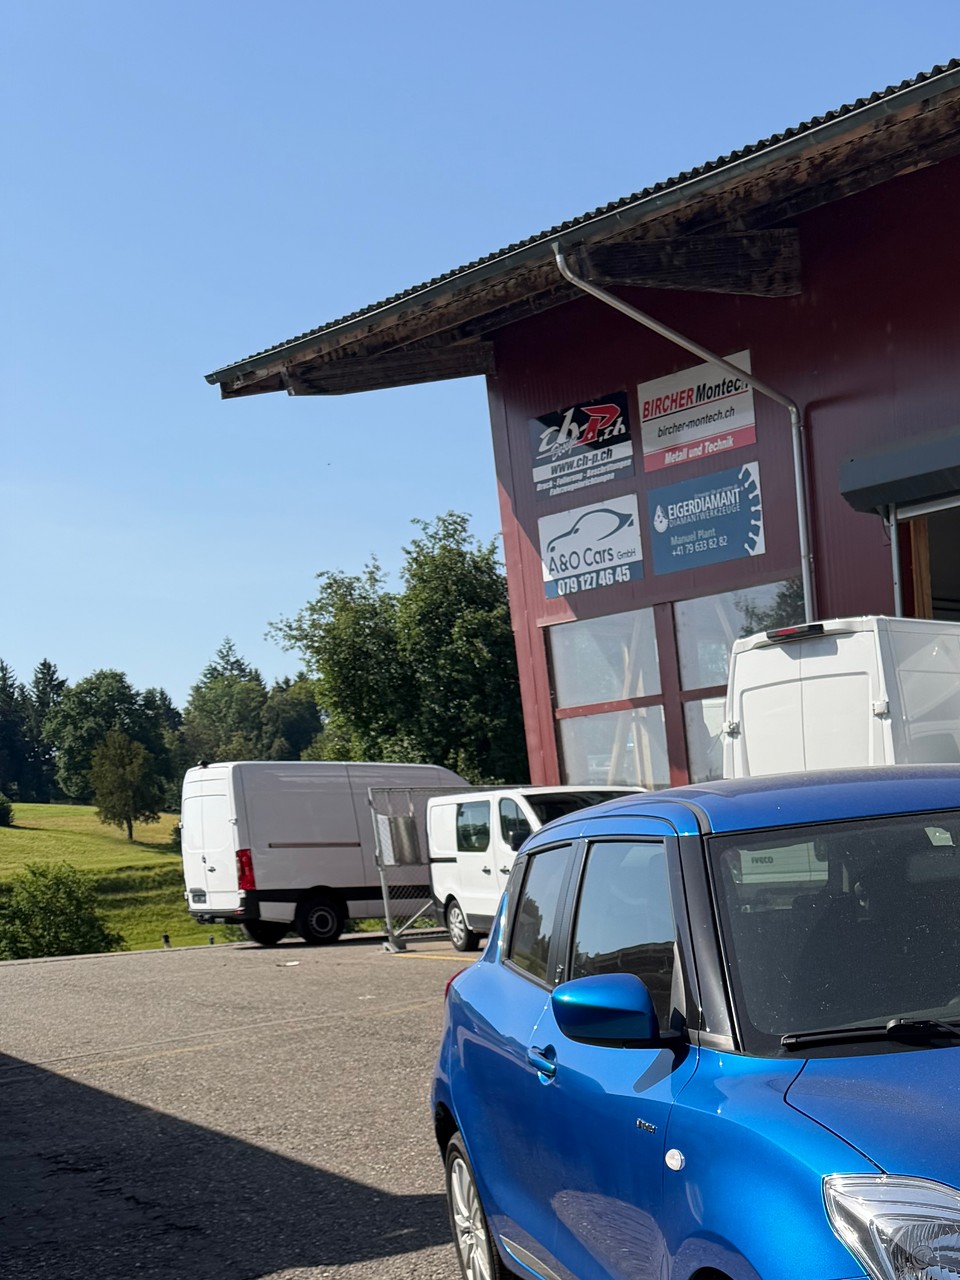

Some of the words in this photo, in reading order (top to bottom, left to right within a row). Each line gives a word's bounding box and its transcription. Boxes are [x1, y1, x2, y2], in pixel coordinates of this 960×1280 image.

[642, 387, 694, 419] BIRCHER
[657, 406, 735, 437] bircher-montech.ch
[550, 447, 613, 475] www.ch-p.ch
[664, 447, 688, 464] Metall
[689, 443, 703, 457] und
[704, 435, 734, 453] Technik
[668, 487, 740, 520] EIGERDIAMANT
[669, 502, 740, 528] DIAMANTWERKZEUGE
[670, 531, 696, 545] Manuel
[697, 528, 716, 540] Plant
[671, 545, 683, 556] +41
[685, 543, 694, 554] 79
[695, 541, 708, 552] 633
[708, 538, 718, 549] 82
[719, 535, 728, 546] 82
[549, 551, 580, 576] A&O
[583, 547, 614, 567] Cars
[617, 547, 636, 560] GmbH
[557, 576, 578, 596] 079
[579, 572, 597, 591] 127
[598, 569, 613, 586] 46
[615, 565, 631, 583] 45
[751, 856, 774, 865] IVECO
